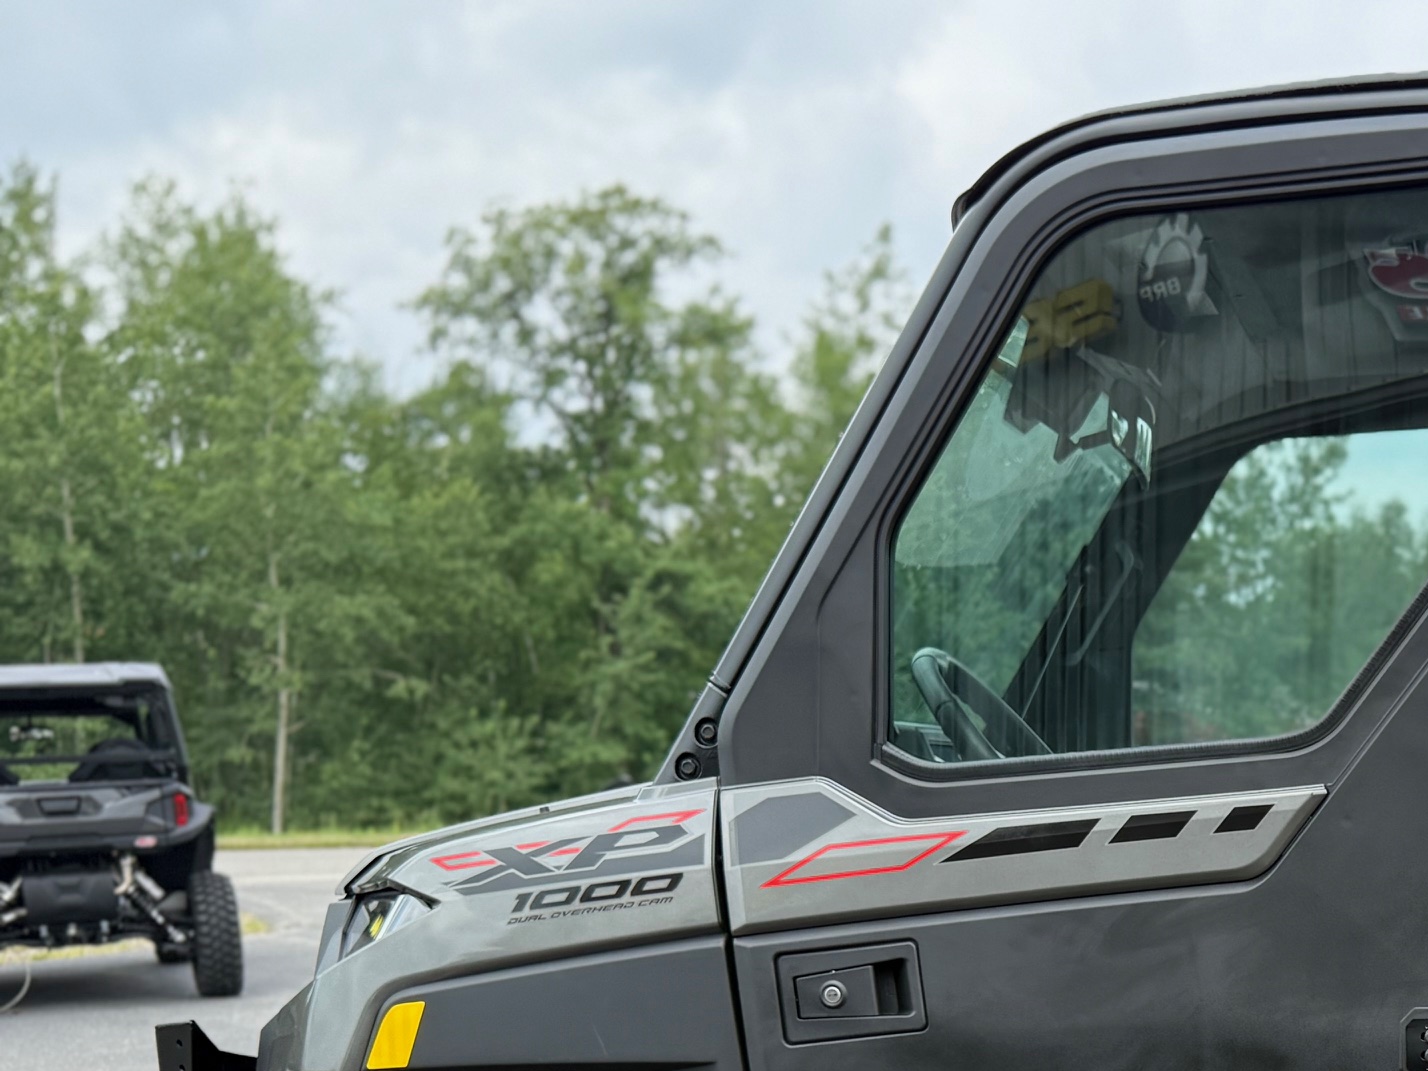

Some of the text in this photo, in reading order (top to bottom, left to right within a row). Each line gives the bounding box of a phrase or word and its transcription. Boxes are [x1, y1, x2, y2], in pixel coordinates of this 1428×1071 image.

[511, 873, 684, 913] 1000
[507, 896, 674, 925] DUAL OVERHEAD CAM
